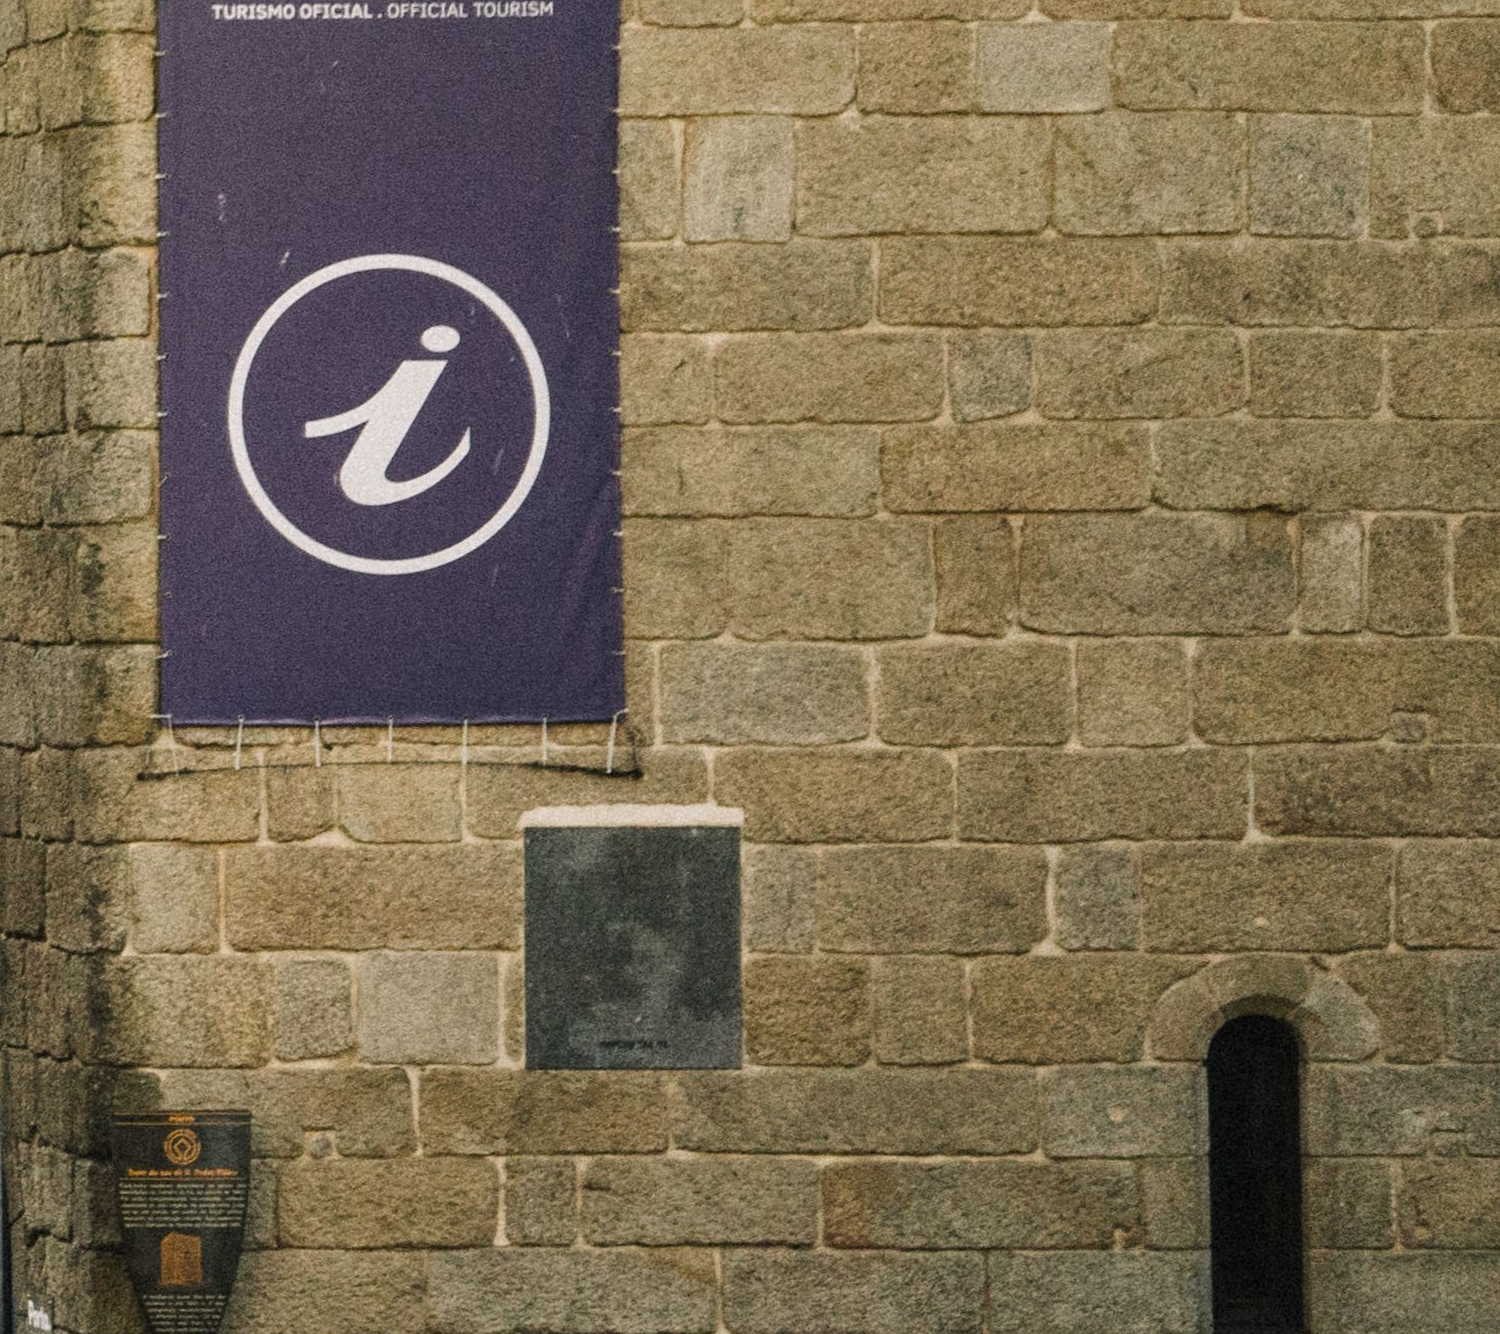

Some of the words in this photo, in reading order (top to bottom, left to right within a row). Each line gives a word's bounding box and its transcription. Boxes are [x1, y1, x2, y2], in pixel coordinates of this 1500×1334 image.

[211, 3, 296, 21] TURISMO
[299, 2, 374, 20] OFICIAL
[386, 1, 469, 19] OFFICIAL
[472, 0, 554, 18] TOURISM
